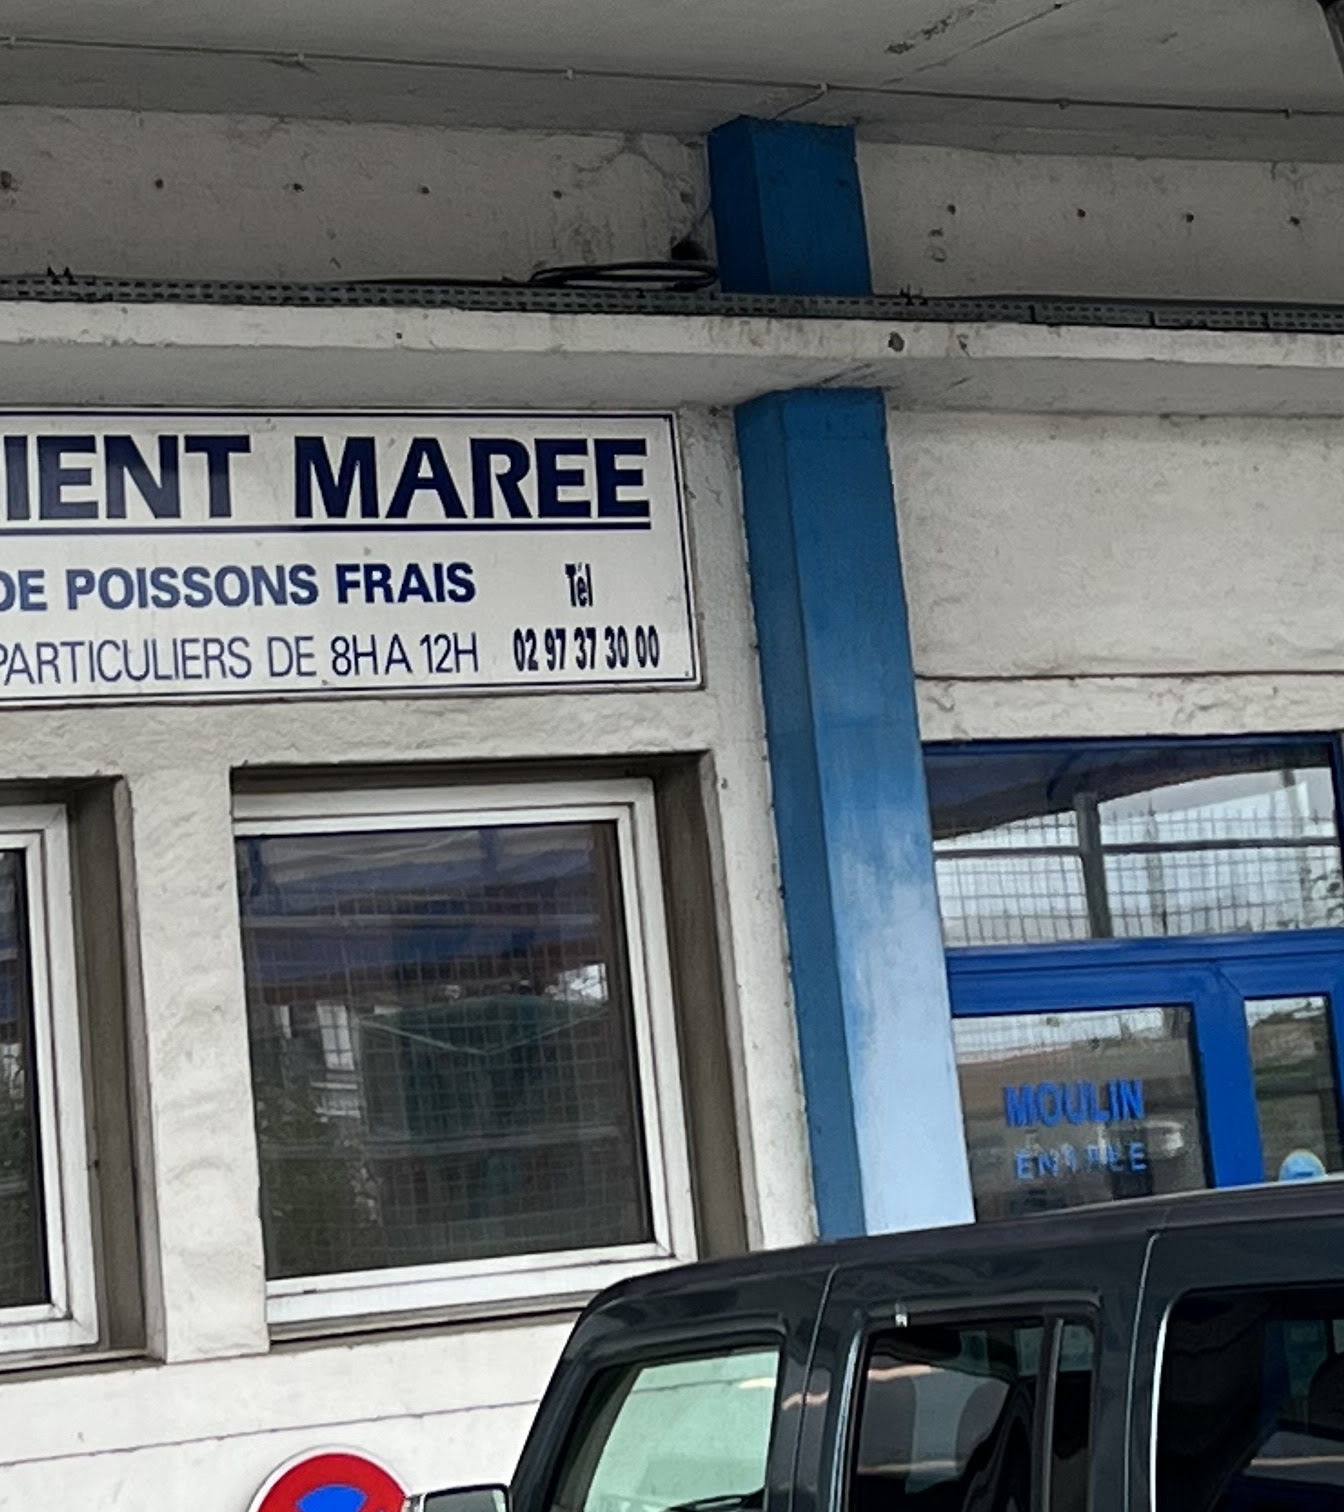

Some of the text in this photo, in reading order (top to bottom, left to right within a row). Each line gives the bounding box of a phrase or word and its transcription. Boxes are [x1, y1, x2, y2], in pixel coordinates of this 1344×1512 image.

[293, 435, 652, 520] MAREE
[66, 563, 319, 611] POISSONS
[335, 561, 476, 605] FRAIS
[564, 562, 594, 608] Tél
[267, 635, 317, 678] DE
[419, 631, 479, 674] 12H
[513, 624, 660, 672] 02 97 37 30 00
[1005, 1078, 1144, 1127] MOULIN
